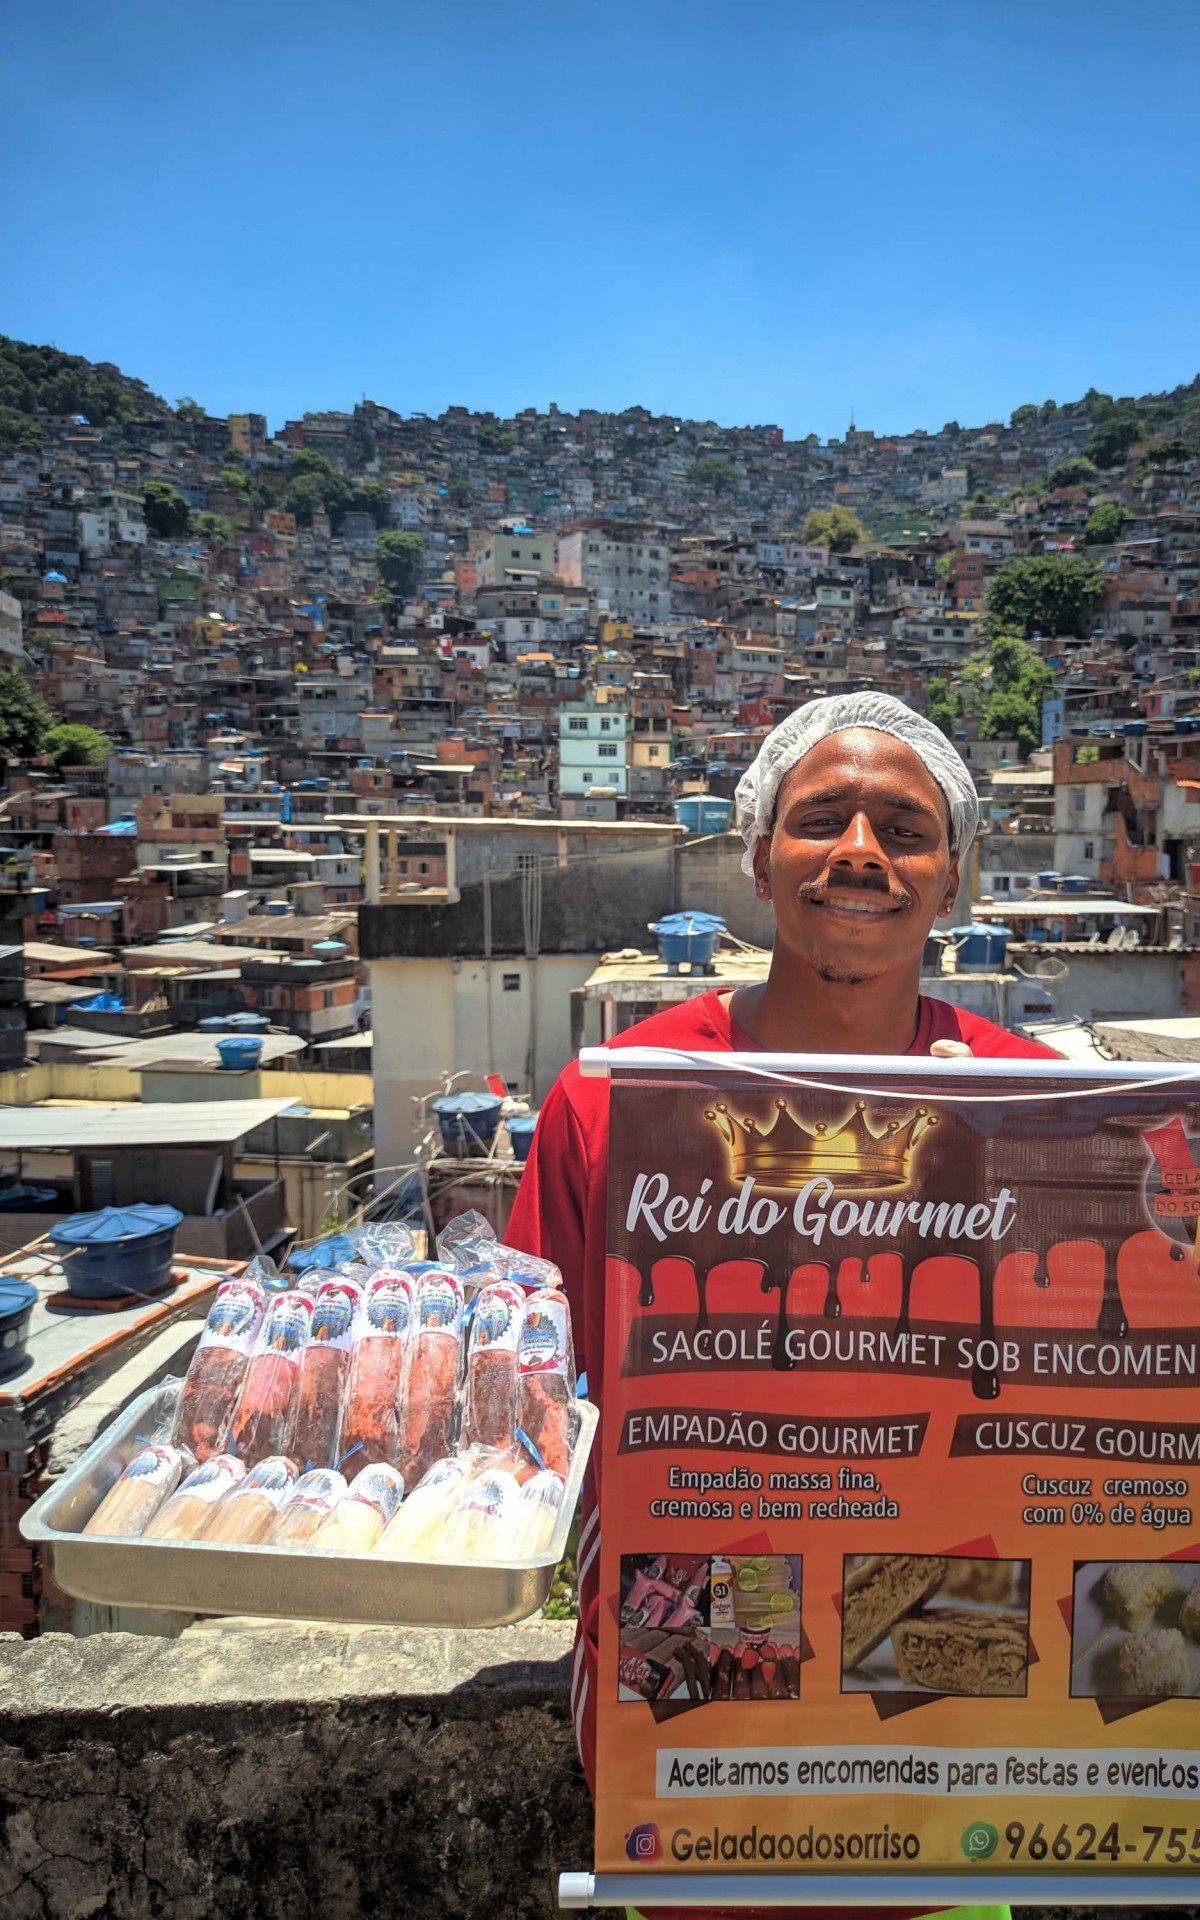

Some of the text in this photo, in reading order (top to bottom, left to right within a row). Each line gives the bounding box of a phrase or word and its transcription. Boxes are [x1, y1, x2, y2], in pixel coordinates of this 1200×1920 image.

[625, 1172, 1017, 1247] Rei do Gourmet
[1156, 1200, 1177, 1213] DO
[652, 1319, 1196, 1376] SACOLÉ GOURMET SOB ENCOMEN
[628, 1411, 920, 1455] EMPADÃO GOURMET
[975, 1421, 1200, 1460] CUSCUZ GOURM
[668, 1466, 882, 1494] Empadão massa fina,
[1022, 1474, 1188, 1496] Cuscuz cremoso
[650, 1496, 899, 1519] cremosa e bem recheada
[1023, 1502, 1192, 1530] com 0% de água
[668, 1754, 1200, 1793] Aceitamos encomendas para festas e eventos
[671, 1823, 921, 1862] Geladaodosorriso
